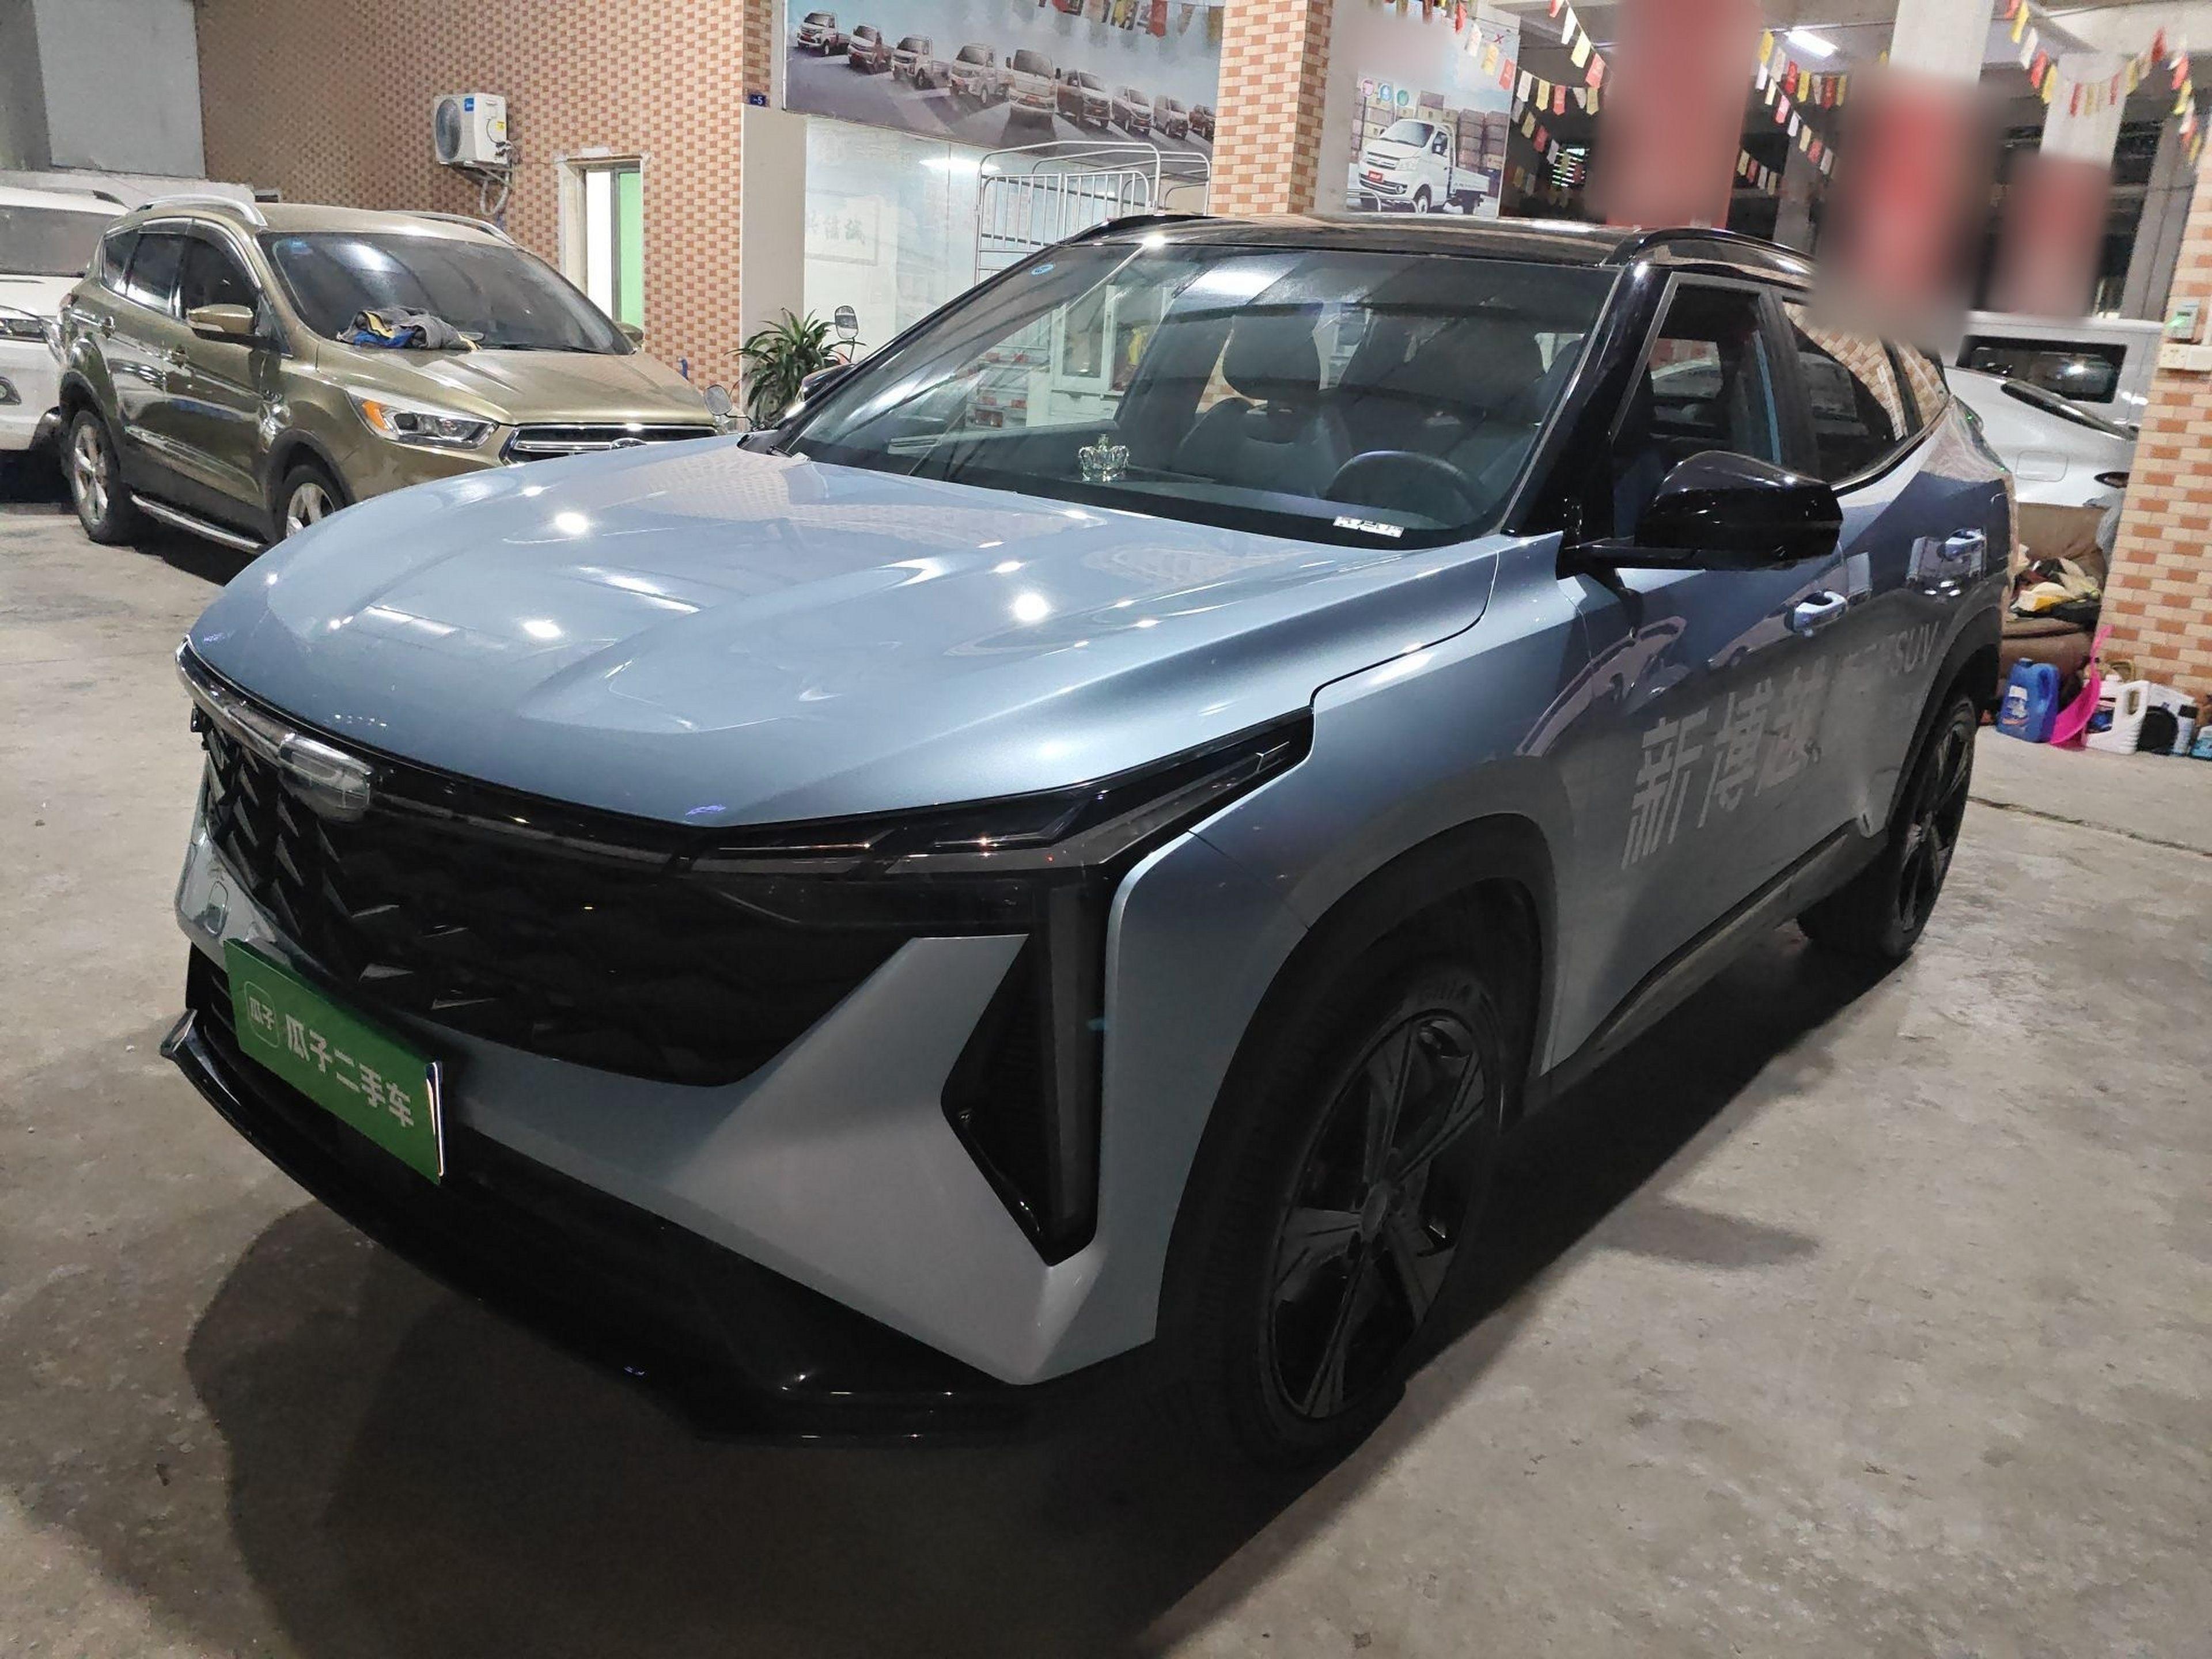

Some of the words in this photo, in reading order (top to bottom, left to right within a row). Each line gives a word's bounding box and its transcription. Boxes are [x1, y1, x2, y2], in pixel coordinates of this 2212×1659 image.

[248, 996, 275, 1031] 瓜子
[285, 1014, 415, 1128] 瓜子二手车
